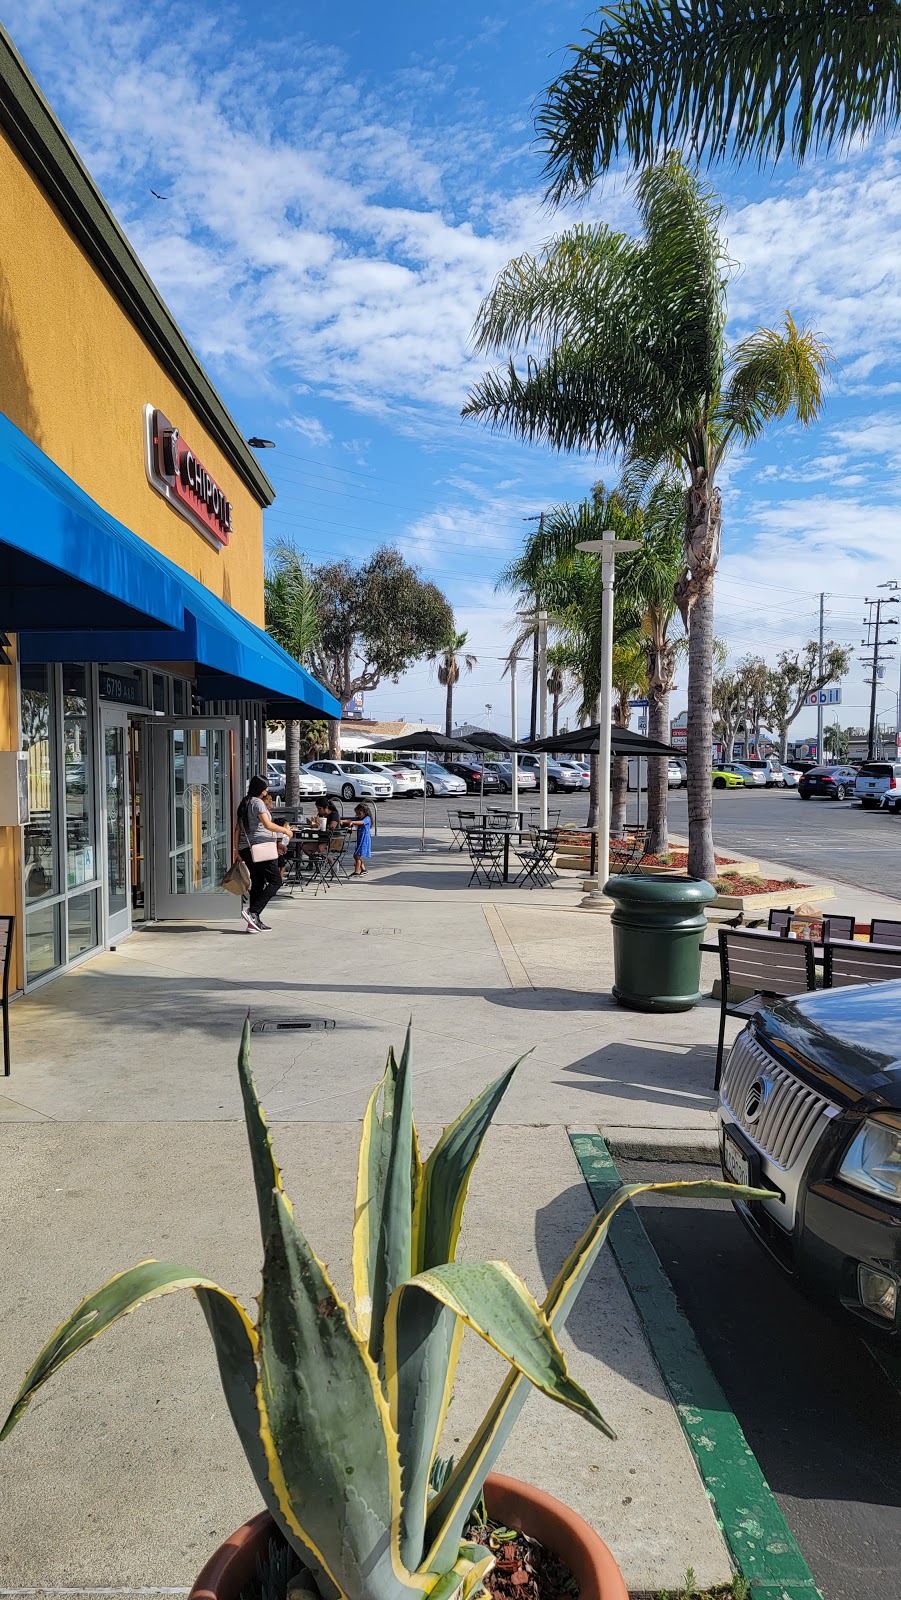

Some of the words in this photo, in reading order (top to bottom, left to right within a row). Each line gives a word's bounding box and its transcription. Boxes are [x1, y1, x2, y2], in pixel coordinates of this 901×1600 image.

[185, 450, 233, 533] CHIPOTLE
[106, 677, 122, 697] 6719
[805, 689, 839, 704] obil
